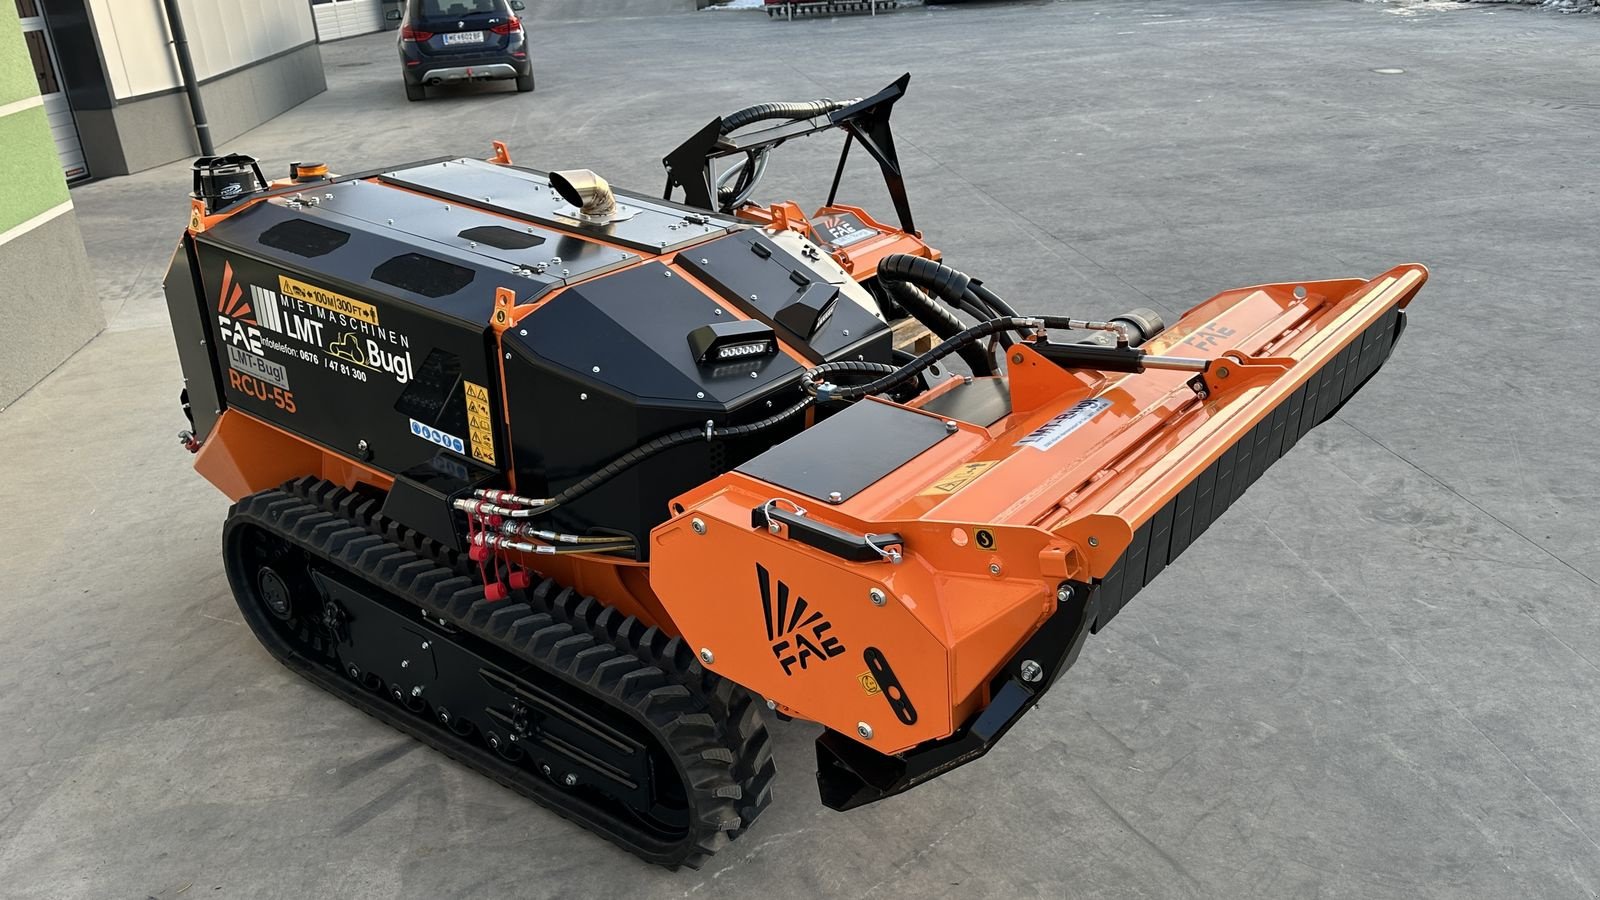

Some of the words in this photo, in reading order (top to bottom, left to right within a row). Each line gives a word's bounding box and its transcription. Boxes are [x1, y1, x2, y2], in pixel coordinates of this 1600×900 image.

[829, 222, 857, 239] FAE
[218, 315, 265, 357] FAE
[280, 293, 409, 349] MIETMASCHINEN
[1183, 322, 1237, 352] FAE
[230, 346, 284, 382] LMT-Bugl
[283, 310, 324, 348] LMT
[366, 339, 414, 384] Bugl
[299, 349, 319, 366] 0676
[329, 360, 339, 371] 47
[340, 364, 351, 376] 81
[351, 368, 367, 382] 300
[228, 367, 297, 414] RCU-55
[772, 621, 846, 676] FAE
